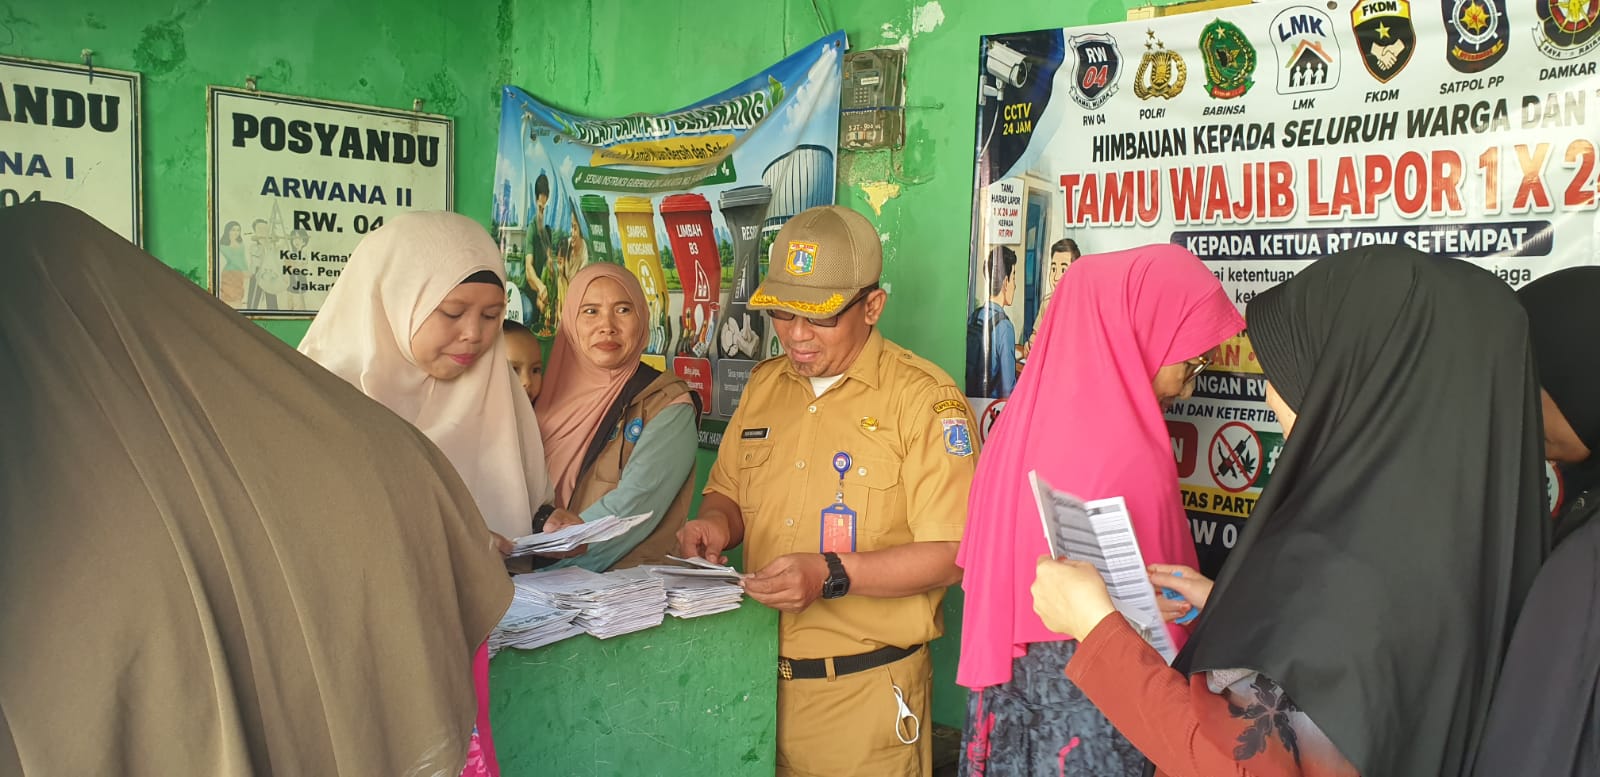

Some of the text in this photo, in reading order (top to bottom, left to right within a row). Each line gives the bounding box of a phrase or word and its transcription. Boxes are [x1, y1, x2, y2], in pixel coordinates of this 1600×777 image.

[1362, 0, 1398, 16] FKDM
[1278, 14, 1327, 42] LMK
[1085, 46, 1108, 63] RW
[1082, 65, 1109, 89] 04
[1539, 62, 1597, 81] DAMKAR
[1439, 75, 1505, 95] SATPOL PP
[1292, 98, 1315, 110] LMK
[1365, 89, 1399, 103] FKDM
[1004, 102, 1032, 120] CCTV
[1083, 113, 1106, 126] RW 04
[1139, 108, 1166, 120] POLRI
[1202, 105, 1246, 116] BABINSA
[1003, 121, 1031, 136] 24 JAM
[1092, 90, 1586, 163] HIMBAUAN KEPADA SELURUH WARGA DAN
[232, 112, 440, 168] POSYANDU
[65, 157, 74, 180] I
[260, 175, 413, 208] ARWANA II
[1001, 183, 1014, 193] TAMU
[1060, 168, 1159, 225] TAMU
[1169, 160, 1296, 225] WAJIB
[1307, 149, 1464, 218] LAPOR
[1478, 146, 1499, 211] 1
[1512, 142, 1551, 210] X
[1007, 196, 1021, 205] LAPOR
[293, 210, 385, 235] RW. 04
[676, 223, 703, 238] LIMBAH
[688, 242, 699, 256] B3
[1187, 232, 1257, 257] KEPADA
[1260, 232, 1322, 256] KETUA
[1403, 227, 1528, 254] SETEMPAT
[280, 250, 352, 263] Kel. Kama
[282, 265, 345, 278] Kec. Pen
[1212, 265, 1532, 285] ai ketentuan jaga
[1235, 289, 1259, 304] ket
[1194, 375, 1242, 396] NGAN
[1187, 404, 1214, 418] DAN
[1216, 406, 1279, 423] KETERTIB
[1212, 494, 1257, 514] PART
[1189, 517, 1217, 546] W
